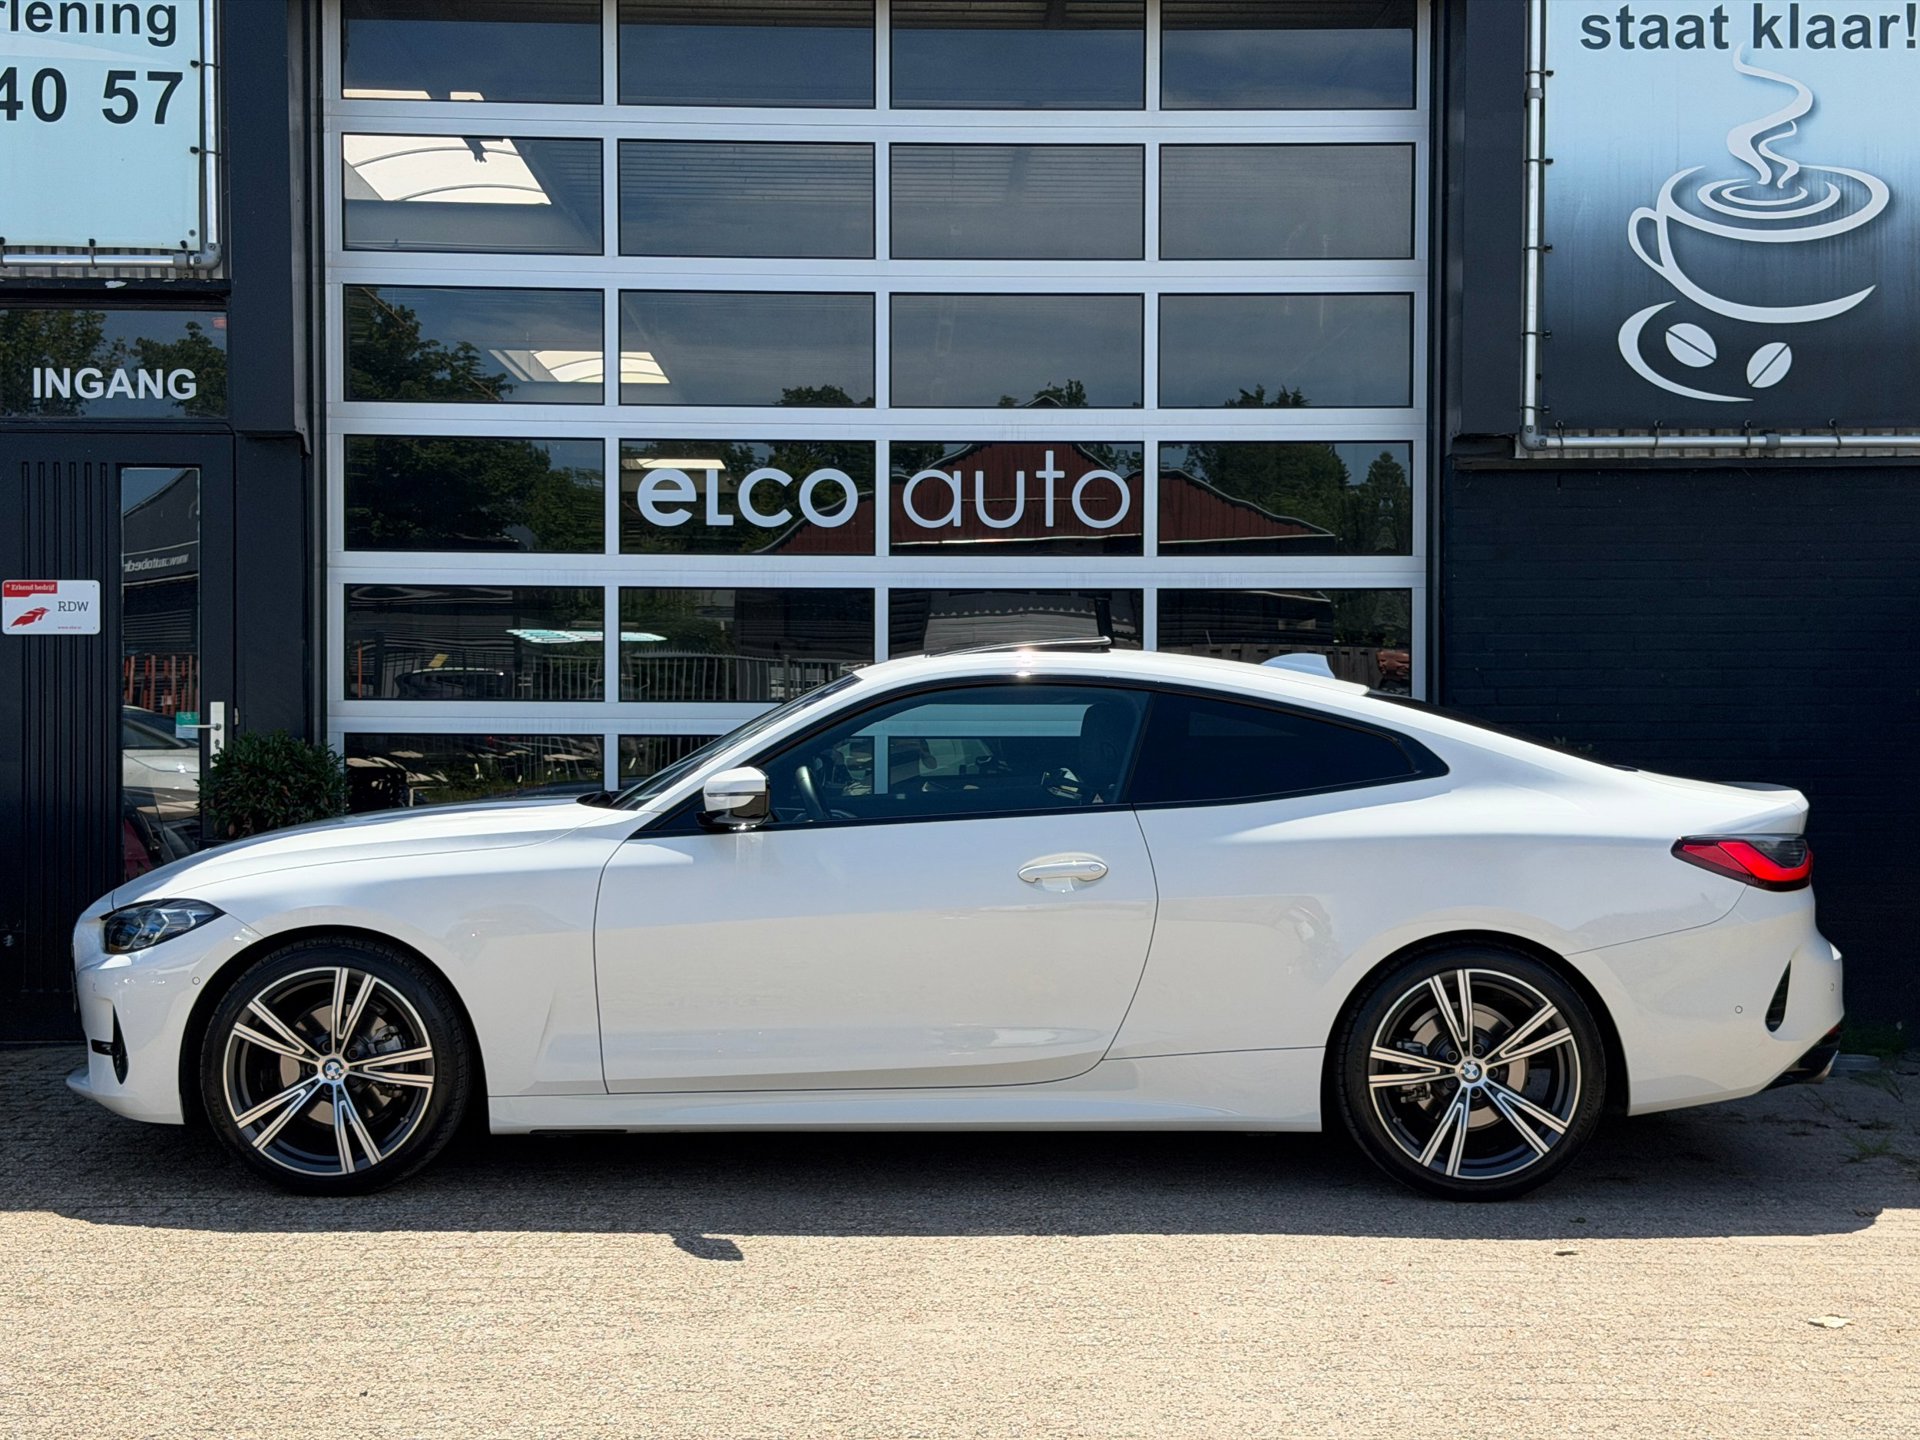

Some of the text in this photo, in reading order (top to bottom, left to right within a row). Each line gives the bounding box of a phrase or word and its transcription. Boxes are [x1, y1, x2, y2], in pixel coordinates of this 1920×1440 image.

[0, 0, 177, 47] lening
[1580, 3, 1916, 50] staat klaar!
[0, 66, 183, 124] 40 57
[33, 367, 197, 400] INGANG
[903, 450, 1131, 528] auto
[58, 601, 89, 612] RDW
